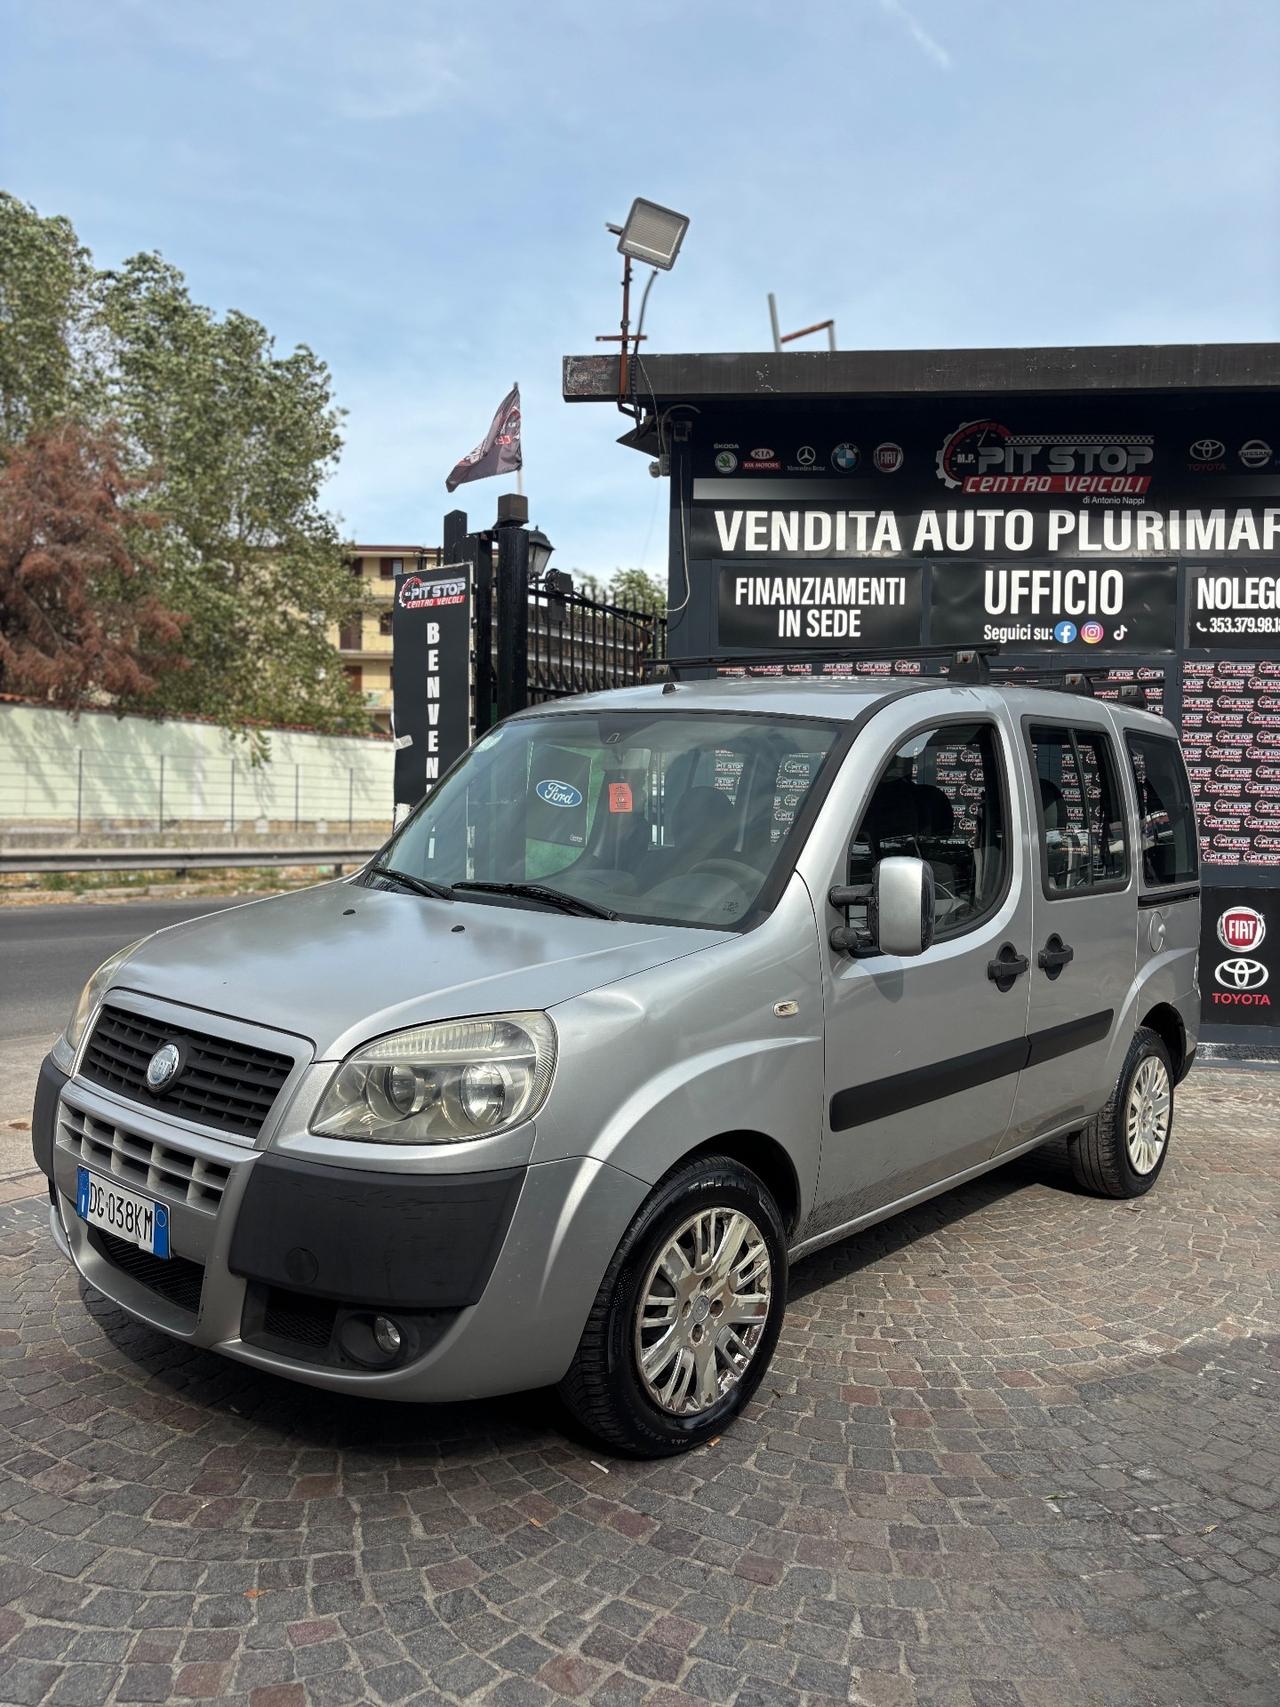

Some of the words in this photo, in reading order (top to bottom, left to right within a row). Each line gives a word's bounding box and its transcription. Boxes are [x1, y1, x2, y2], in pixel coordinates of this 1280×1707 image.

[880, 451, 897, 465] FIAT
[977, 446, 1042, 474] PIT
[1047, 446, 1153, 474] STOP
[1187, 463, 1226, 472] TOYOTA
[1082, 496, 1090, 504] di
[1122, 497, 1145, 505] Nappi
[714, 511, 902, 551] VENDITA
[912, 509, 1034, 551] AUTO
[1048, 508, 1280, 551] PLURIMAR
[411, 586, 431, 600] PIT
[432, 582, 466, 597] STOP
[735, 577, 906, 605] FINANZIAMENTI
[984, 569, 1124, 615] UFFICIO
[778, 609, 801, 637] IN
[806, 609, 861, 637] SEDE
[1209, 616, 1280, 633] 353.379.98.1
[983, 624, 1031, 643] Seguici
[1034, 626, 1053, 640] su:
[544, 782, 574, 805] Ford
[1228, 920, 1255, 939] FIAT
[1212, 993, 1271, 1005] TOYOTA
